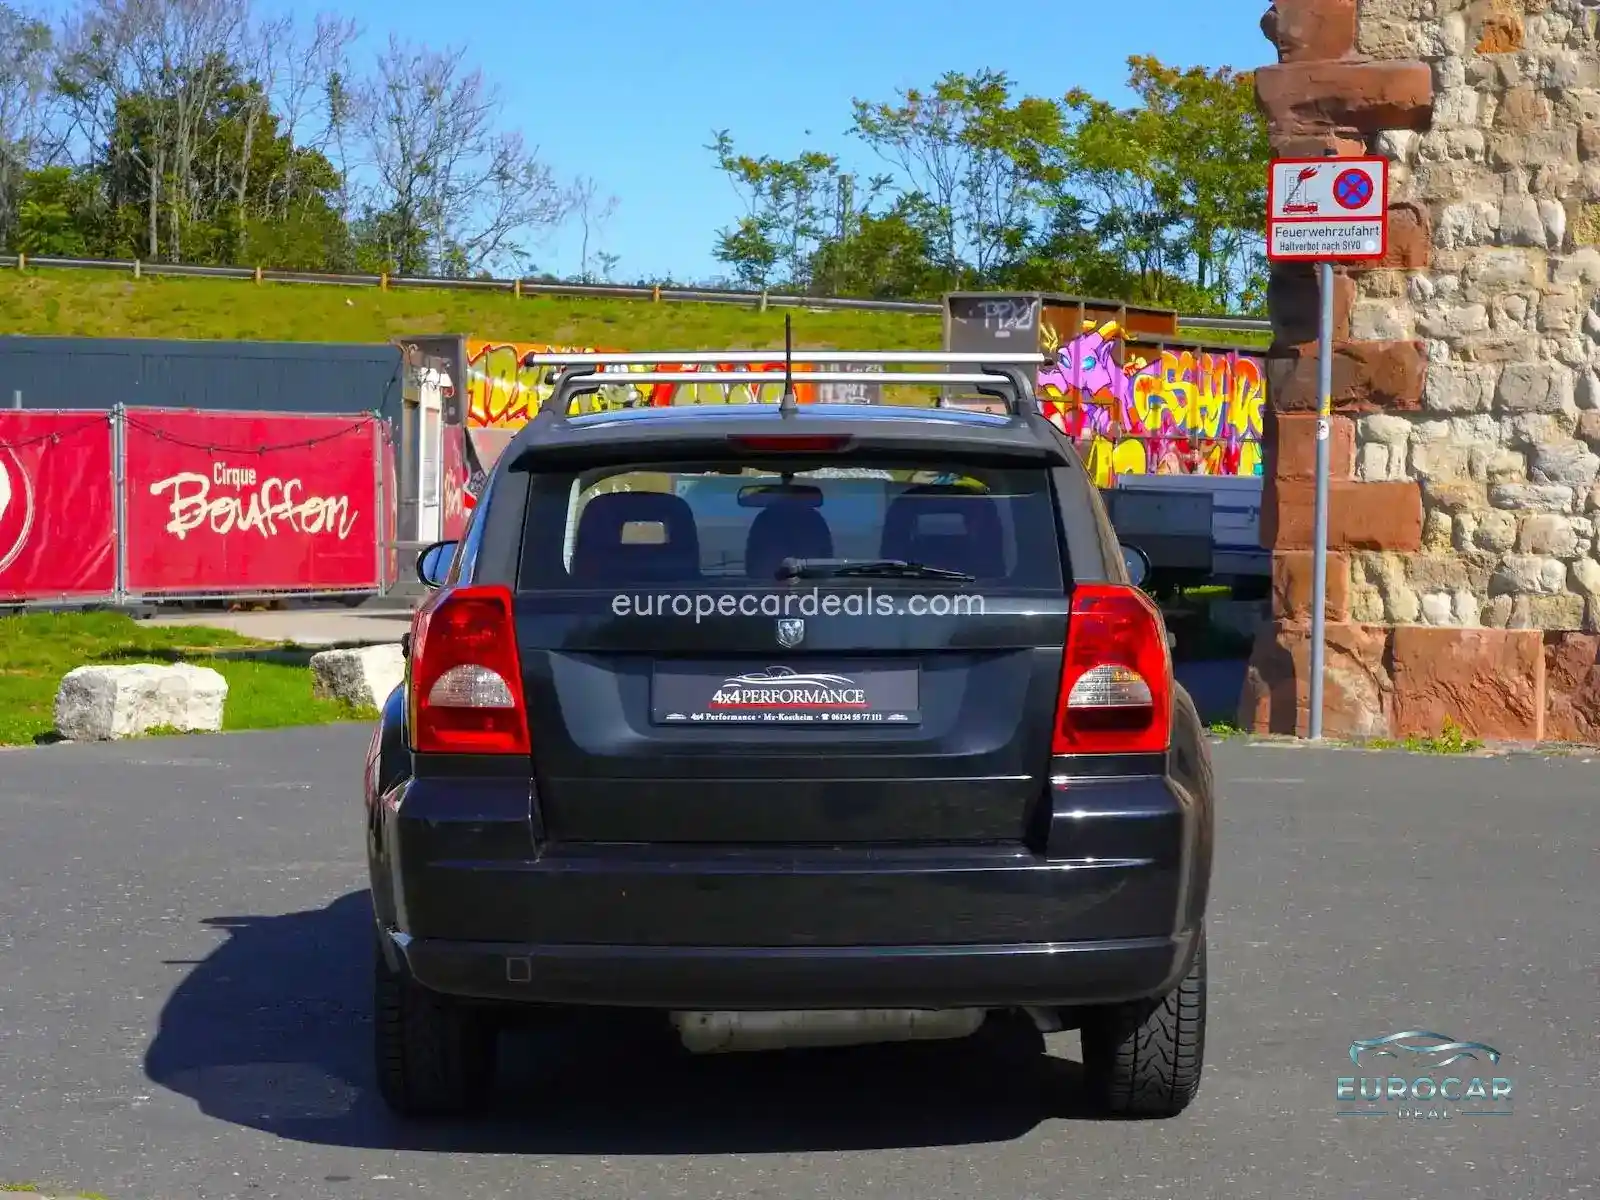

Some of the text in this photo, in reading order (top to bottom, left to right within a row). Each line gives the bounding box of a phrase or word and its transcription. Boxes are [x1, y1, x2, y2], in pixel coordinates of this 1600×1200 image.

[1275, 225, 1379, 238] Feuerwehrzufahrt
[1280, 239, 1361, 251] Haltverbot nach StVO
[213, 461, 257, 492] Cirque
[150, 472, 358, 540] Bouffon
[690, 712, 704, 721] 4x4
[706, 713, 756, 721] Performance
[831, 713, 851, 721] 06134
[852, 713, 860, 721] 55
[862, 713, 870, 721] 77
[871, 713, 882, 721] 111
